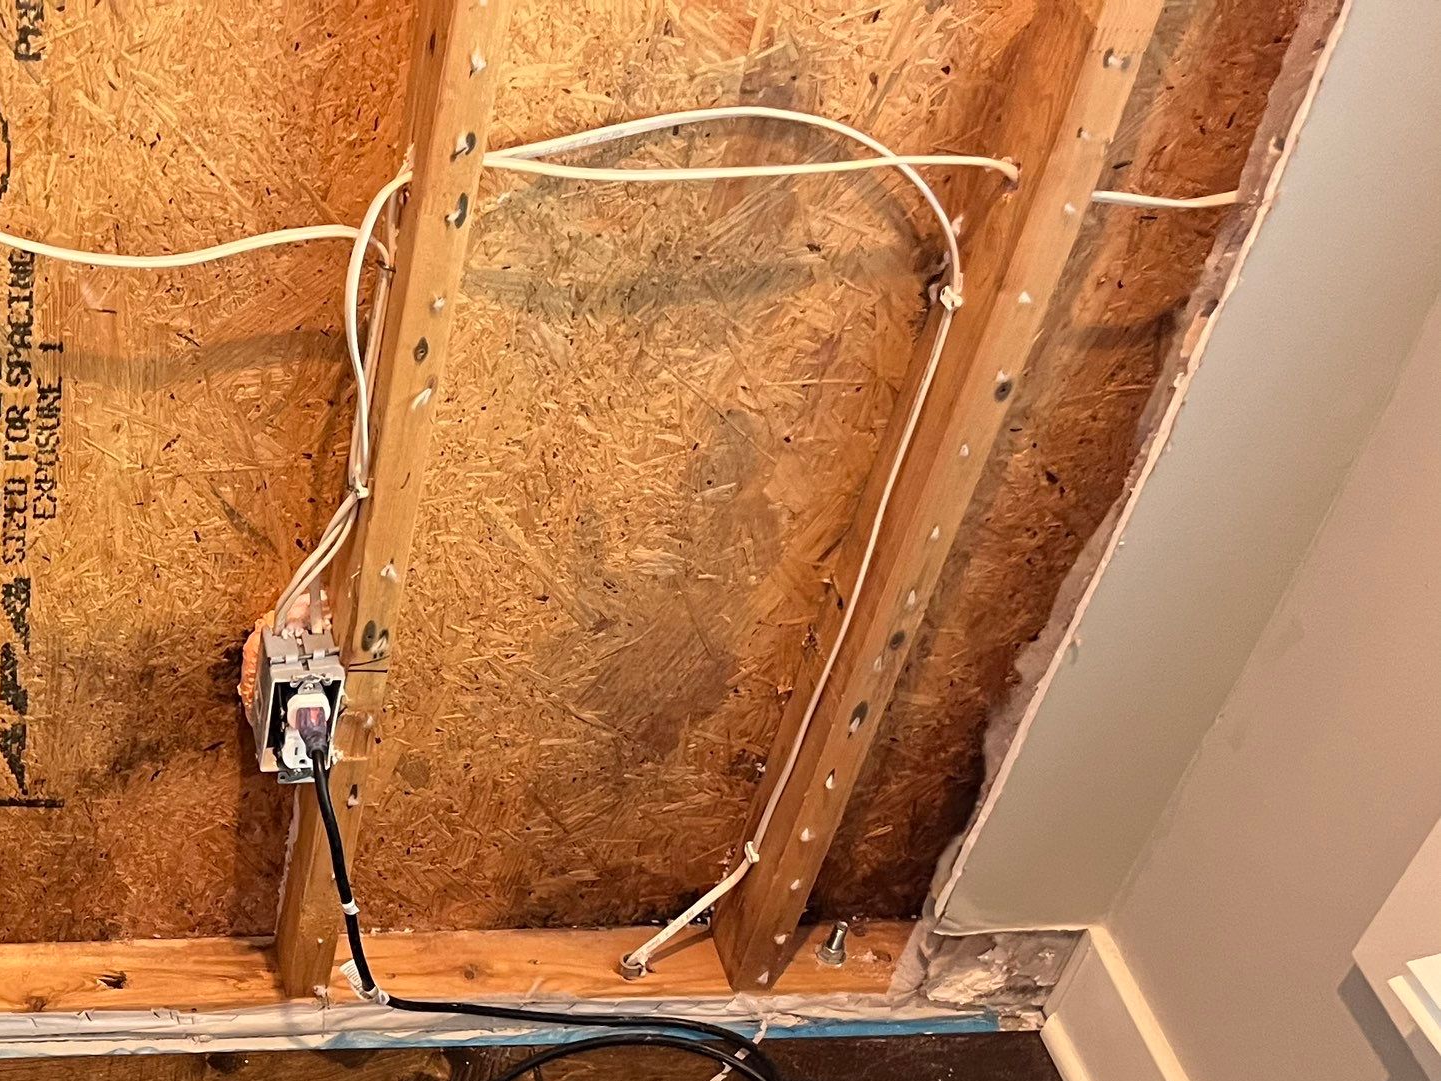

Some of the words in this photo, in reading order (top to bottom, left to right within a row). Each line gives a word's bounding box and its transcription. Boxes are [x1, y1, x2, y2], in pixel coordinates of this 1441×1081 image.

[4, 405, 30, 461] FOR
[33, 376, 63, 520] EXPOSURE
[2, 477, 28, 564] SIZED
